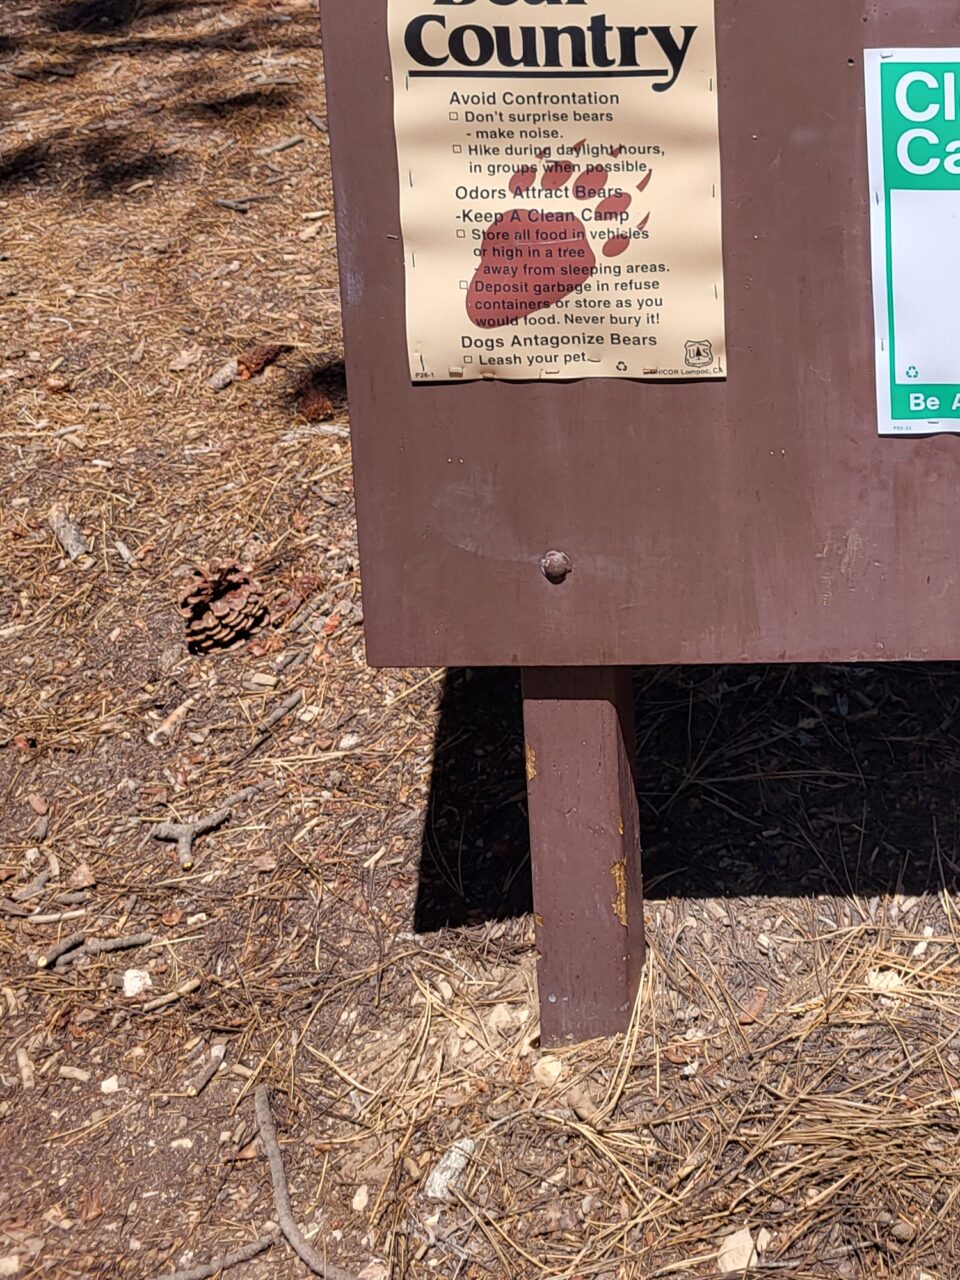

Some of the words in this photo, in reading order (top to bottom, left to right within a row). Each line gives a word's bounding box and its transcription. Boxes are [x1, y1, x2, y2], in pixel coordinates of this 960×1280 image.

[404, 13, 699, 93] Country
[449, 91, 496, 106] Avoid
[502, 91, 620, 106] Confrontation
[465, 111, 504, 123] Don't
[508, 111, 569, 126] surprise
[573, 110, 614, 123] bears
[476, 127, 514, 139] make
[519, 127, 563, 139] noise.
[468, 144, 500, 156] Hike
[504, 143, 552, 160] during
[556, 142, 615, 160] daylight
[619, 142, 665, 158] hours,
[469, 161, 483, 173] in
[487, 162, 538, 176] groups
[543, 161, 581, 173] when
[455, 186, 507, 199] Odors
[513, 185, 570, 199] Attract
[575, 185, 623, 199] Bears
[510, 209, 521, 222] A
[527, 208, 576, 222] Clean
[581, 208, 629, 225] Camp
[471, 229, 510, 241] Store
[514, 229, 530, 241] all
[534, 229, 568, 241] food
[572, 229, 585, 240] in
[590, 228, 649, 240] vehicles
[473, 248, 488, 258] or
[492, 246, 523, 261] high
[528, 246, 540, 258] in
[545, 248, 553, 258] a
[557, 247, 585, 258] tree
[483, 265, 518, 279] away
[523, 263, 556, 275] from
[560, 263, 622, 279] sleeping
[626, 263, 670, 274] areas.
[474, 281, 529, 296] Deposit
[533, 280, 592, 296] garbage
[596, 280, 609, 291] in
[614, 279, 660, 291] refuse
[474, 298, 551, 310] containers
[555, 299, 570, 309] or
[574, 298, 612, 308] store
[616, 298, 632, 308] as
[637, 297, 663, 311] you
[475, 316, 519, 327] would
[523, 314, 560, 326] food.
[564, 314, 605, 326] Never
[610, 313, 641, 328] bury
[646, 313, 660, 324] it!
[461, 335, 504, 351] Dogs
[510, 334, 605, 350] Antagonize
[610, 333, 658, 346] Bears
[478, 354, 522, 366] Leash
[527, 353, 559, 368] your
[909, 392, 940, 411] Be
